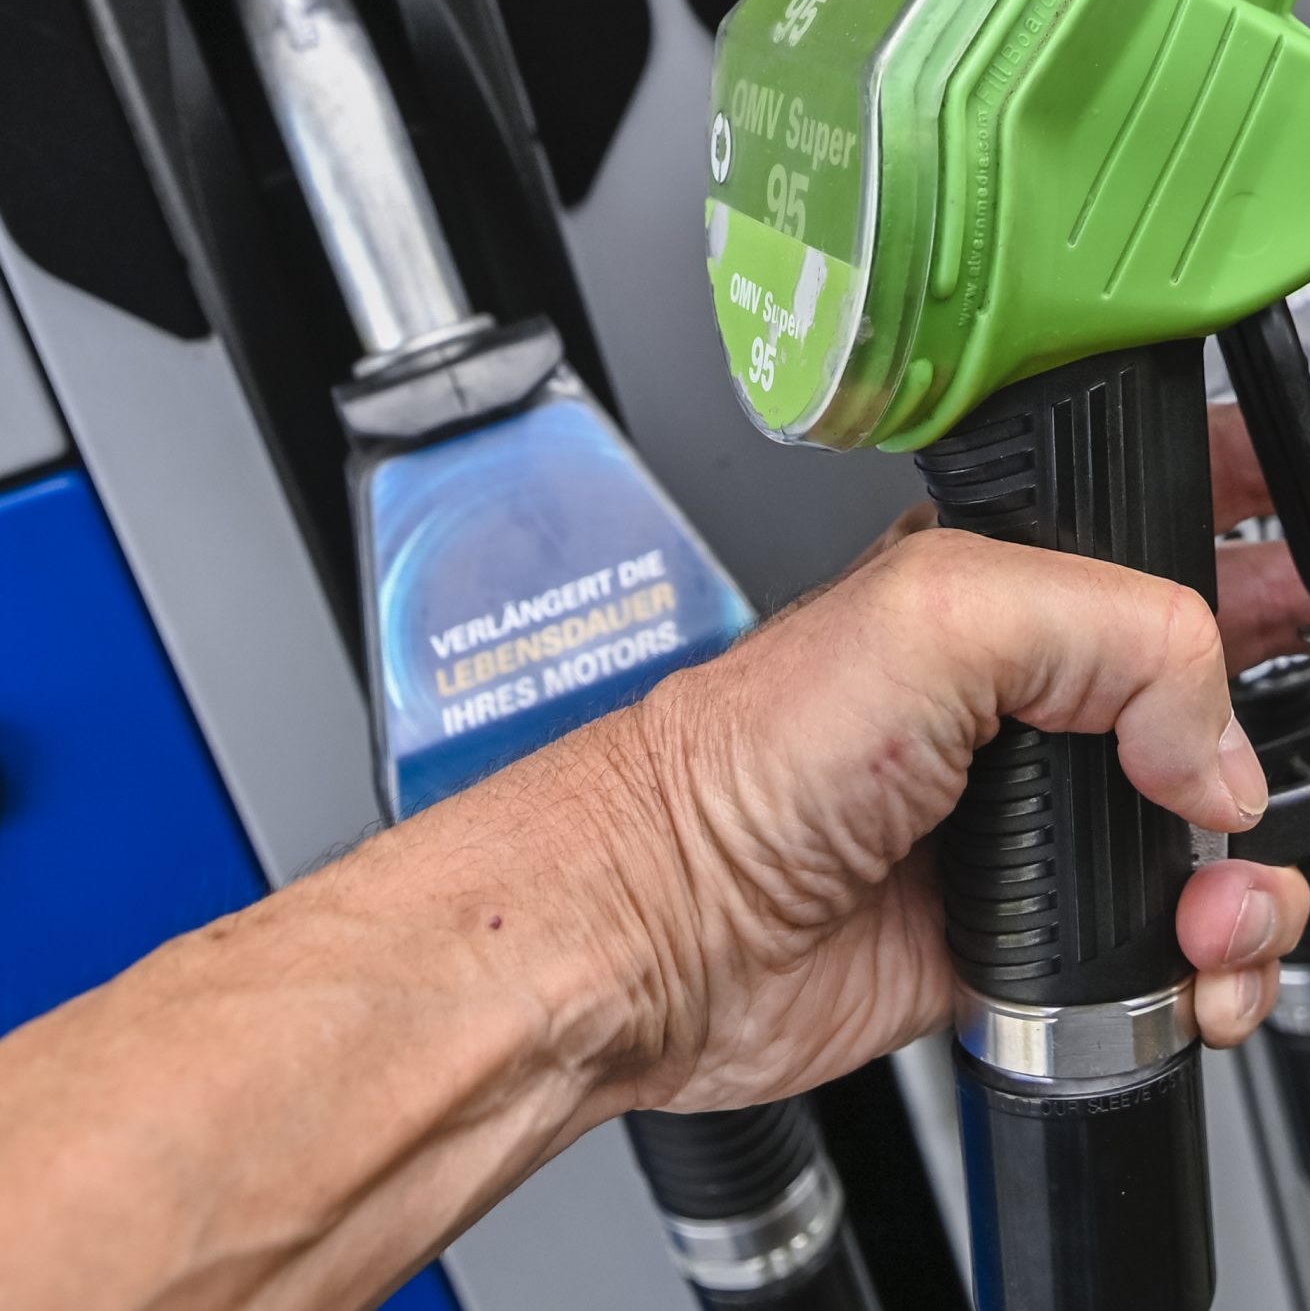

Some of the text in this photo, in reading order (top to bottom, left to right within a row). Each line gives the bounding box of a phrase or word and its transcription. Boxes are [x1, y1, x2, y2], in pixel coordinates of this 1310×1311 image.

[731, 78, 857, 171] OMV Super
[763, 163, 810, 242] 95
[730, 272, 762, 314] OMV
[749, 336, 777, 392] 95
[430, 549, 666, 659] VERLÄNGERT DIE
[437, 582, 677, 698] LEBENSDAUER
[442, 675, 539, 737] IHRES
